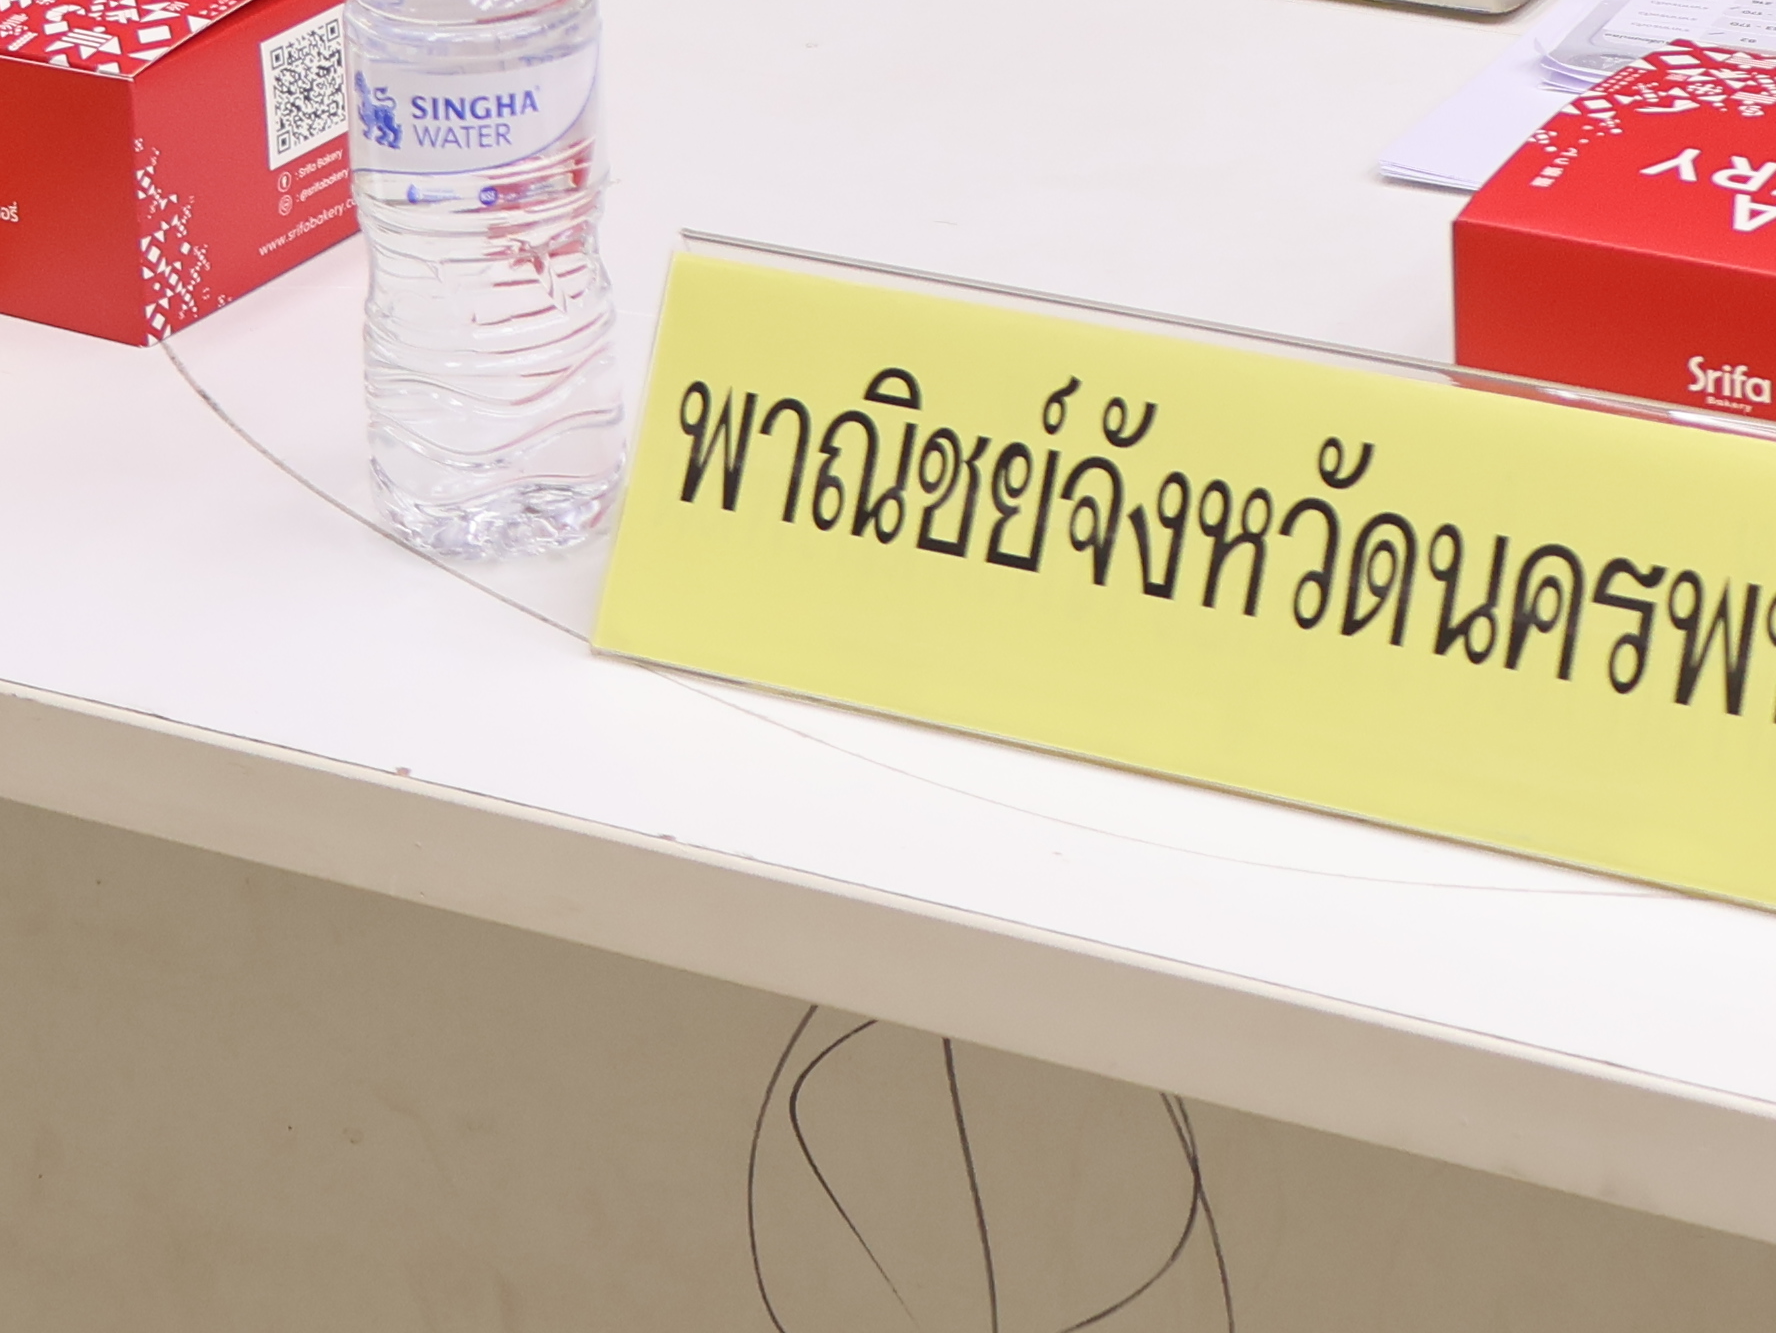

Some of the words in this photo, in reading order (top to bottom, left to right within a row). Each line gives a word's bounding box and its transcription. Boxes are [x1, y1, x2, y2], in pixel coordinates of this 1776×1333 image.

[411, 89, 539, 121] SINGHA
[413, 123, 513, 149] WATER
[1688, 356, 1772, 404] Srifa
